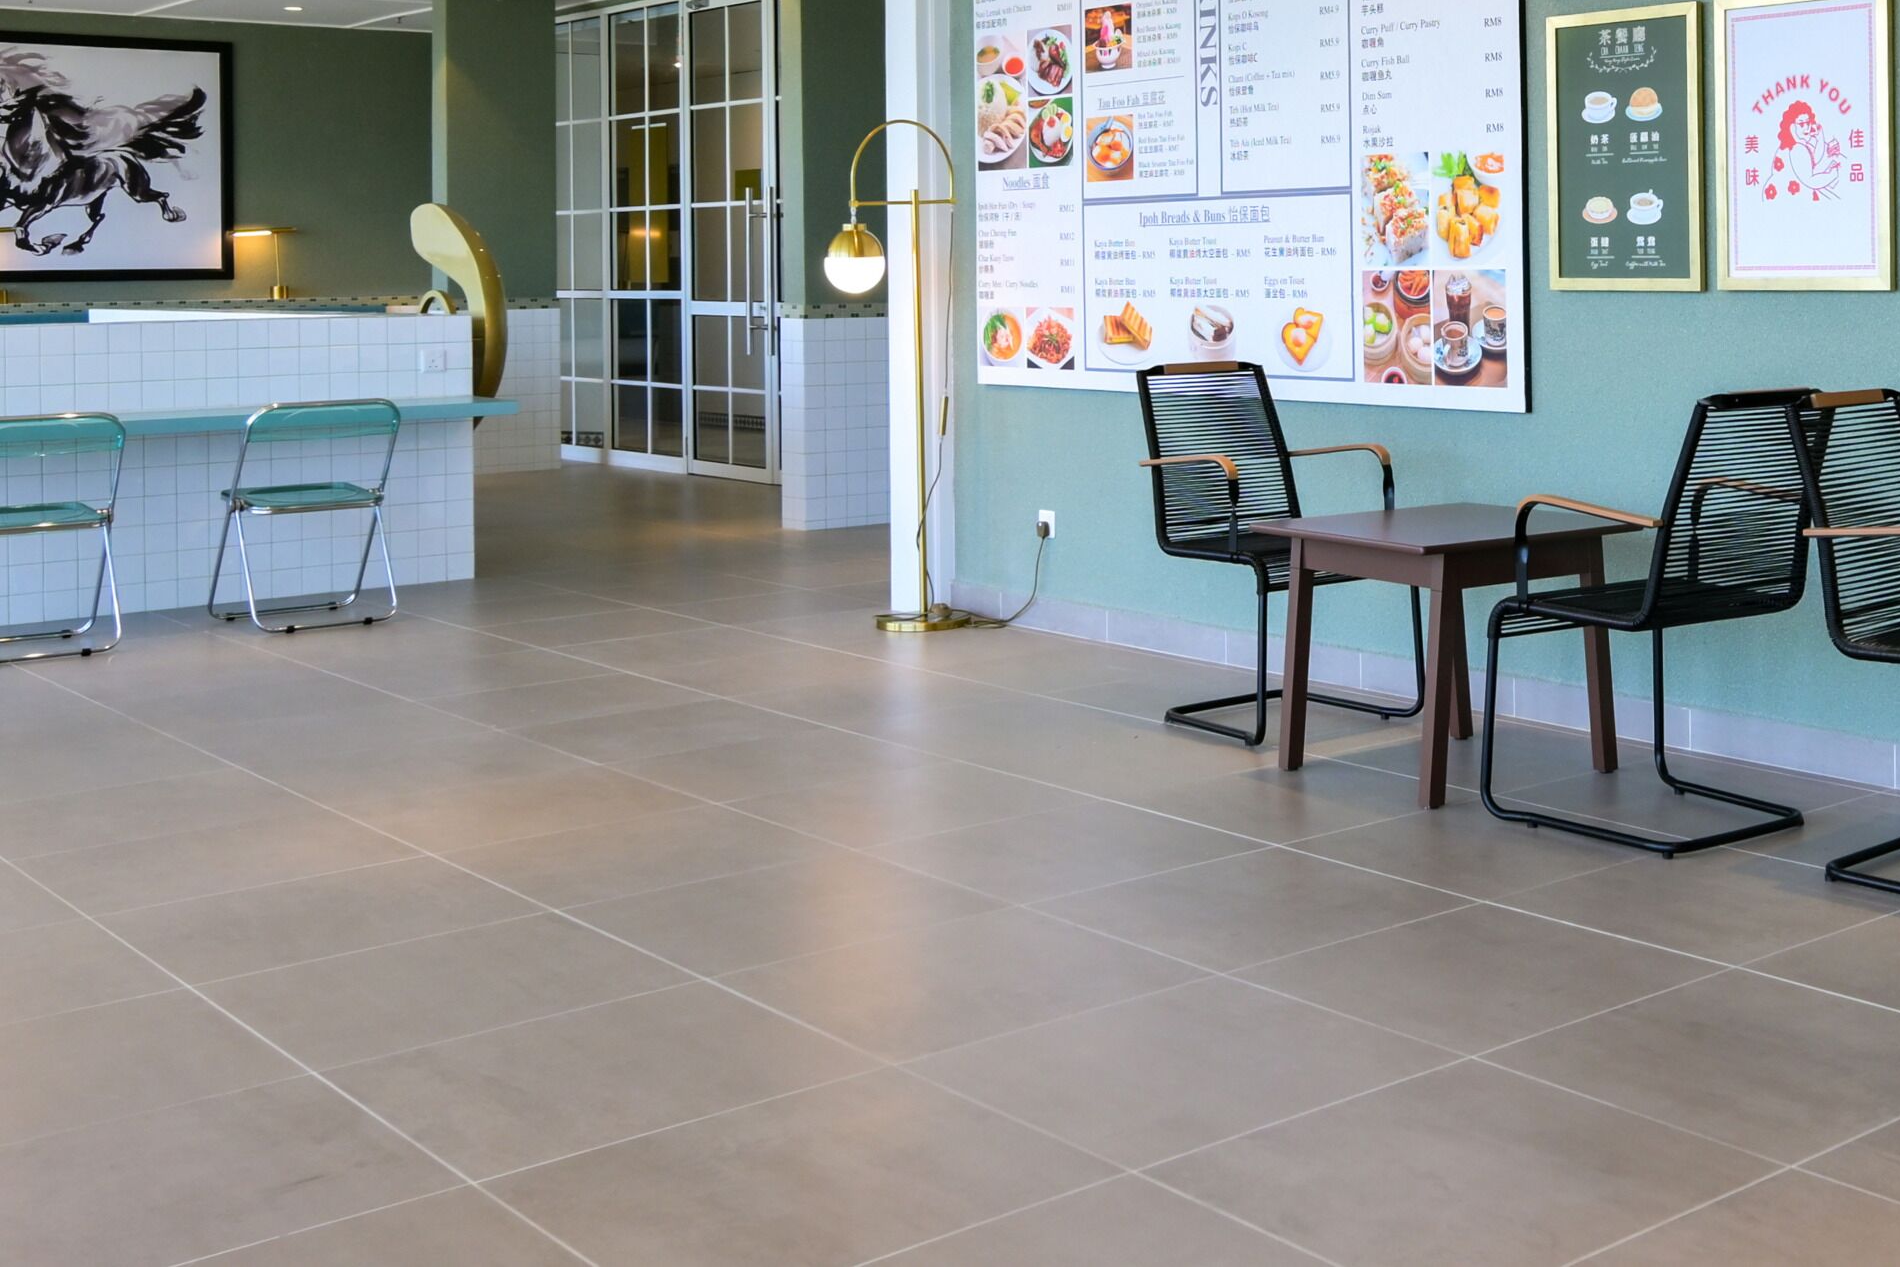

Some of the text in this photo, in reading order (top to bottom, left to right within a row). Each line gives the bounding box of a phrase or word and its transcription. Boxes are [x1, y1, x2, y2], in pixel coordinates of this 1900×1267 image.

[1361, 17, 1440, 36] Curry Puff Curry Pastry
[1484, 16, 1501, 27] RM8
[1361, 54, 1409, 69] Curry Fish Ball
[1484, 52, 1502, 61] RM8
[1362, 92, 1375, 100] Dim
[1485, 88, 1503, 97] RM8
[1752, 74, 1852, 116] THANK YOU
[1486, 123, 1503, 132] RM8
[1745, 135, 1759, 187] 美味
[1849, 128, 1864, 183] 佳品
[1002, 175, 1030, 189] Noodles
[1139, 204, 1269, 227] Ipoh Breads & Buns 怡保面包
